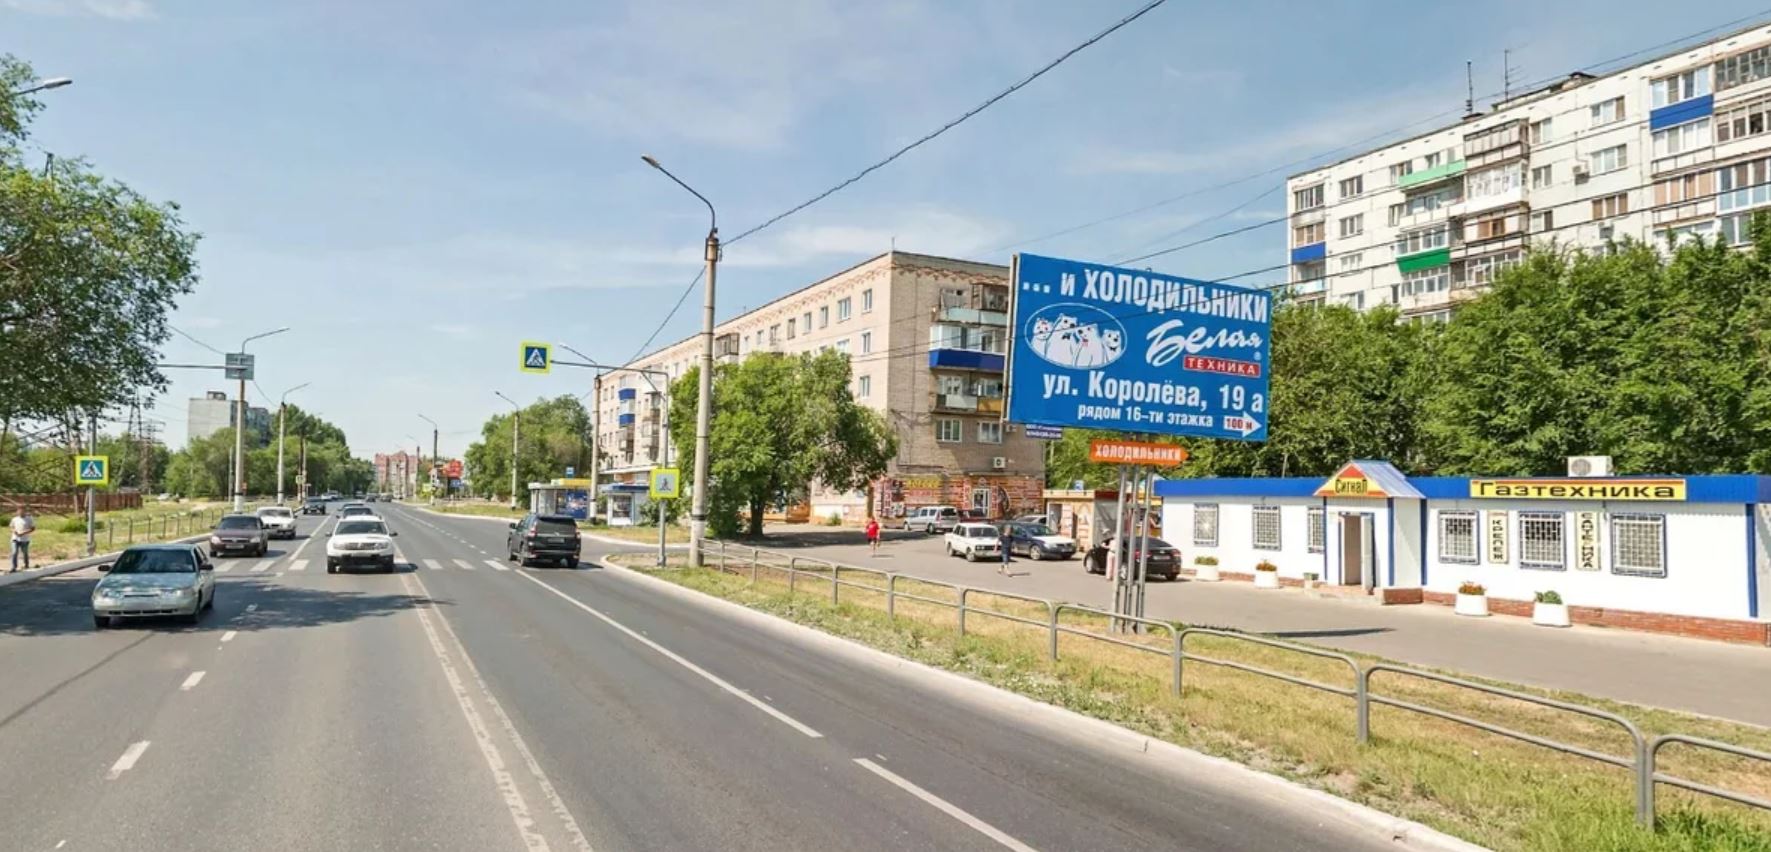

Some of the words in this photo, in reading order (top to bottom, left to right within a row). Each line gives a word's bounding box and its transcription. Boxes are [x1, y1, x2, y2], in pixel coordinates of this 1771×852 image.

[1060, 272, 1075, 296] и
[1082, 269, 1268, 323] ХОЛОДИЛЬНИКИ
[1145, 318, 1263, 367] Белая
[1187, 357, 1257, 375] ТЕХНИКА
[1042, 373, 1078, 399] ул.
[1088, 369, 1207, 412] Королёва,
[1219, 383, 1245, 411] 19
[1251, 392, 1264, 413] а
[1077, 404, 1121, 421] рядом
[1167, 411, 1213, 428] этажка
[1226, 417, 1243, 430] 100
[1479, 481, 1675, 498] Газтехника
